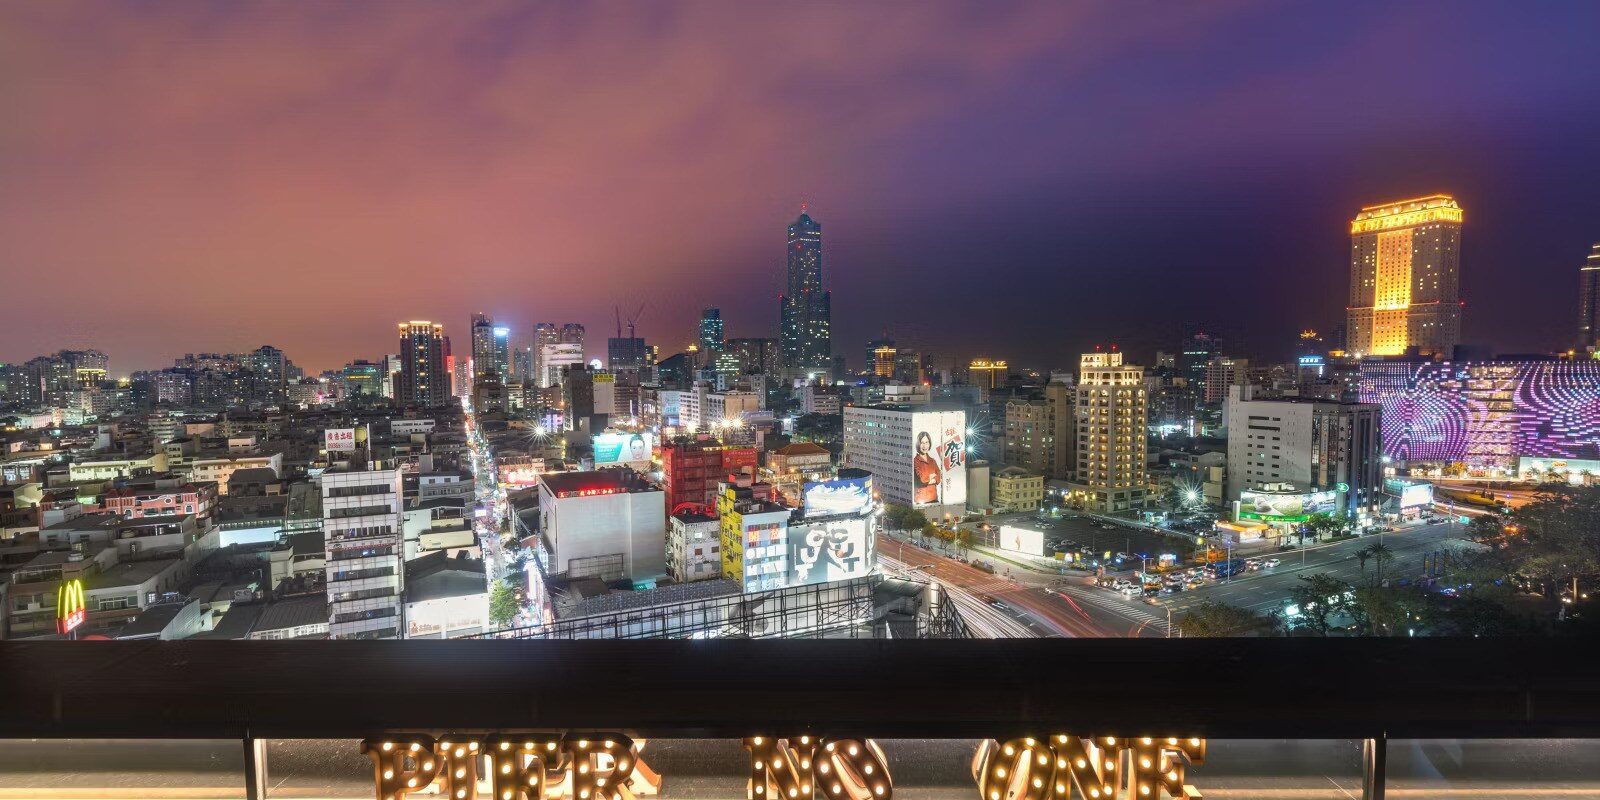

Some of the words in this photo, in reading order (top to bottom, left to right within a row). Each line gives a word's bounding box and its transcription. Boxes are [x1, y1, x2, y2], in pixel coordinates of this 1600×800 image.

[361, 732, 641, 800] PIER
[743, 736, 893, 800] NO
[975, 735, 1205, 800] ONE
